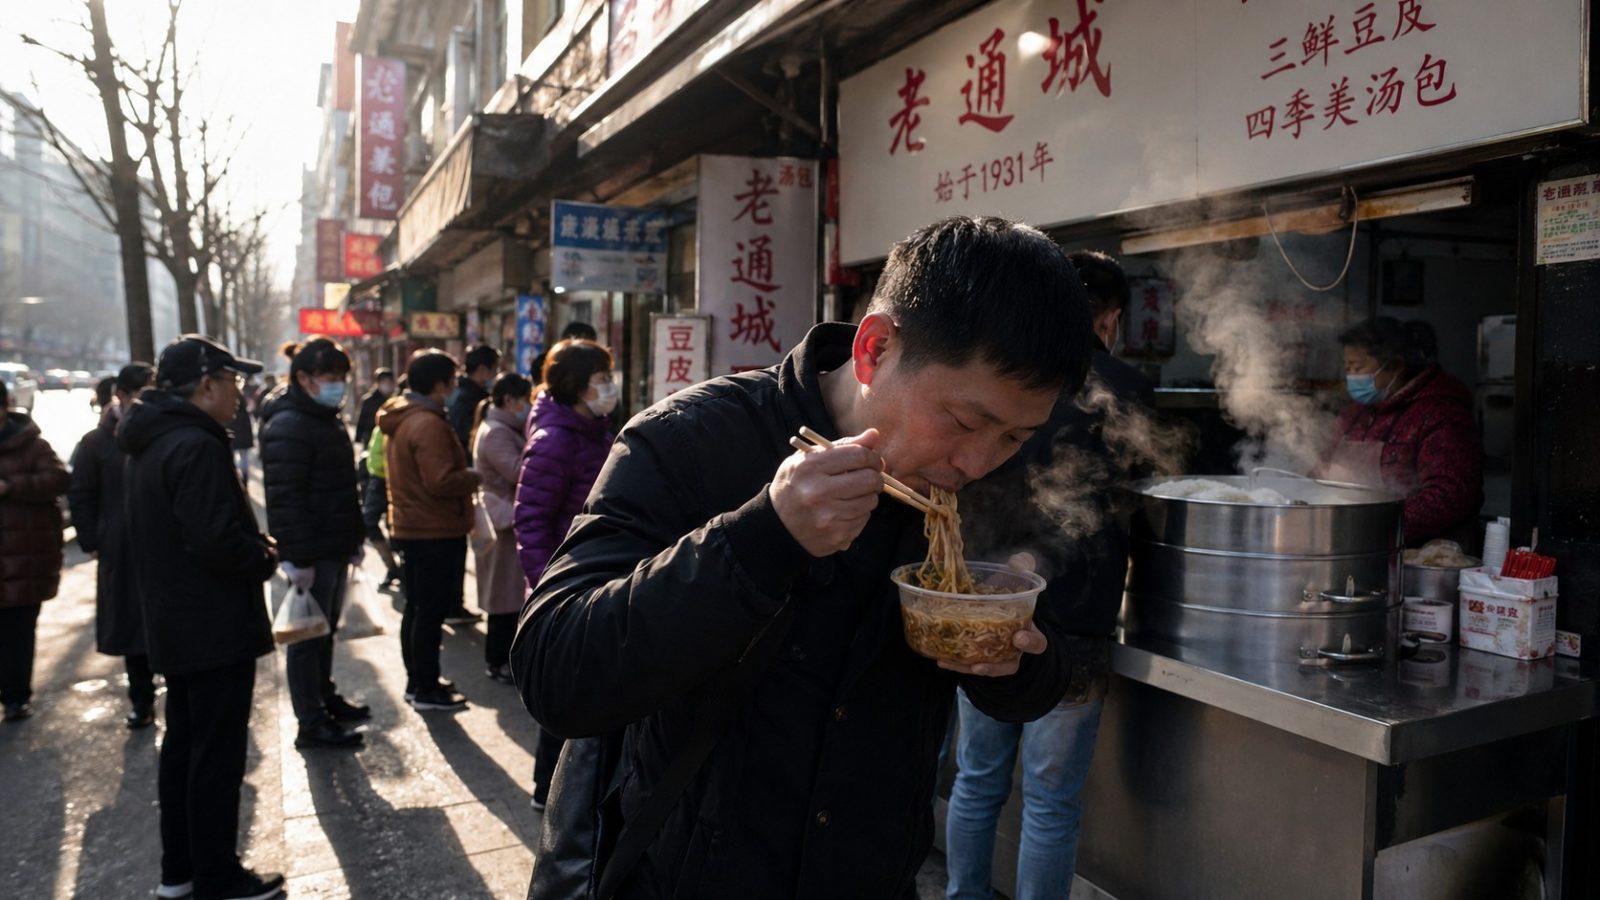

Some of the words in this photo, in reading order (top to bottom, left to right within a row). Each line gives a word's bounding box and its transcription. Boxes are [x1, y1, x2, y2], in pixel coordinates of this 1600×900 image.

[889, 0, 1111, 156] 老通城
[1261, 0, 1437, 80] 三鲜豆皮
[1246, 53, 1457, 140] 四季美汤包
[934, 141, 1054, 203] 始于1931年
[730, 168, 782, 376] 老通城
[665, 325, 694, 396] 豆皮
